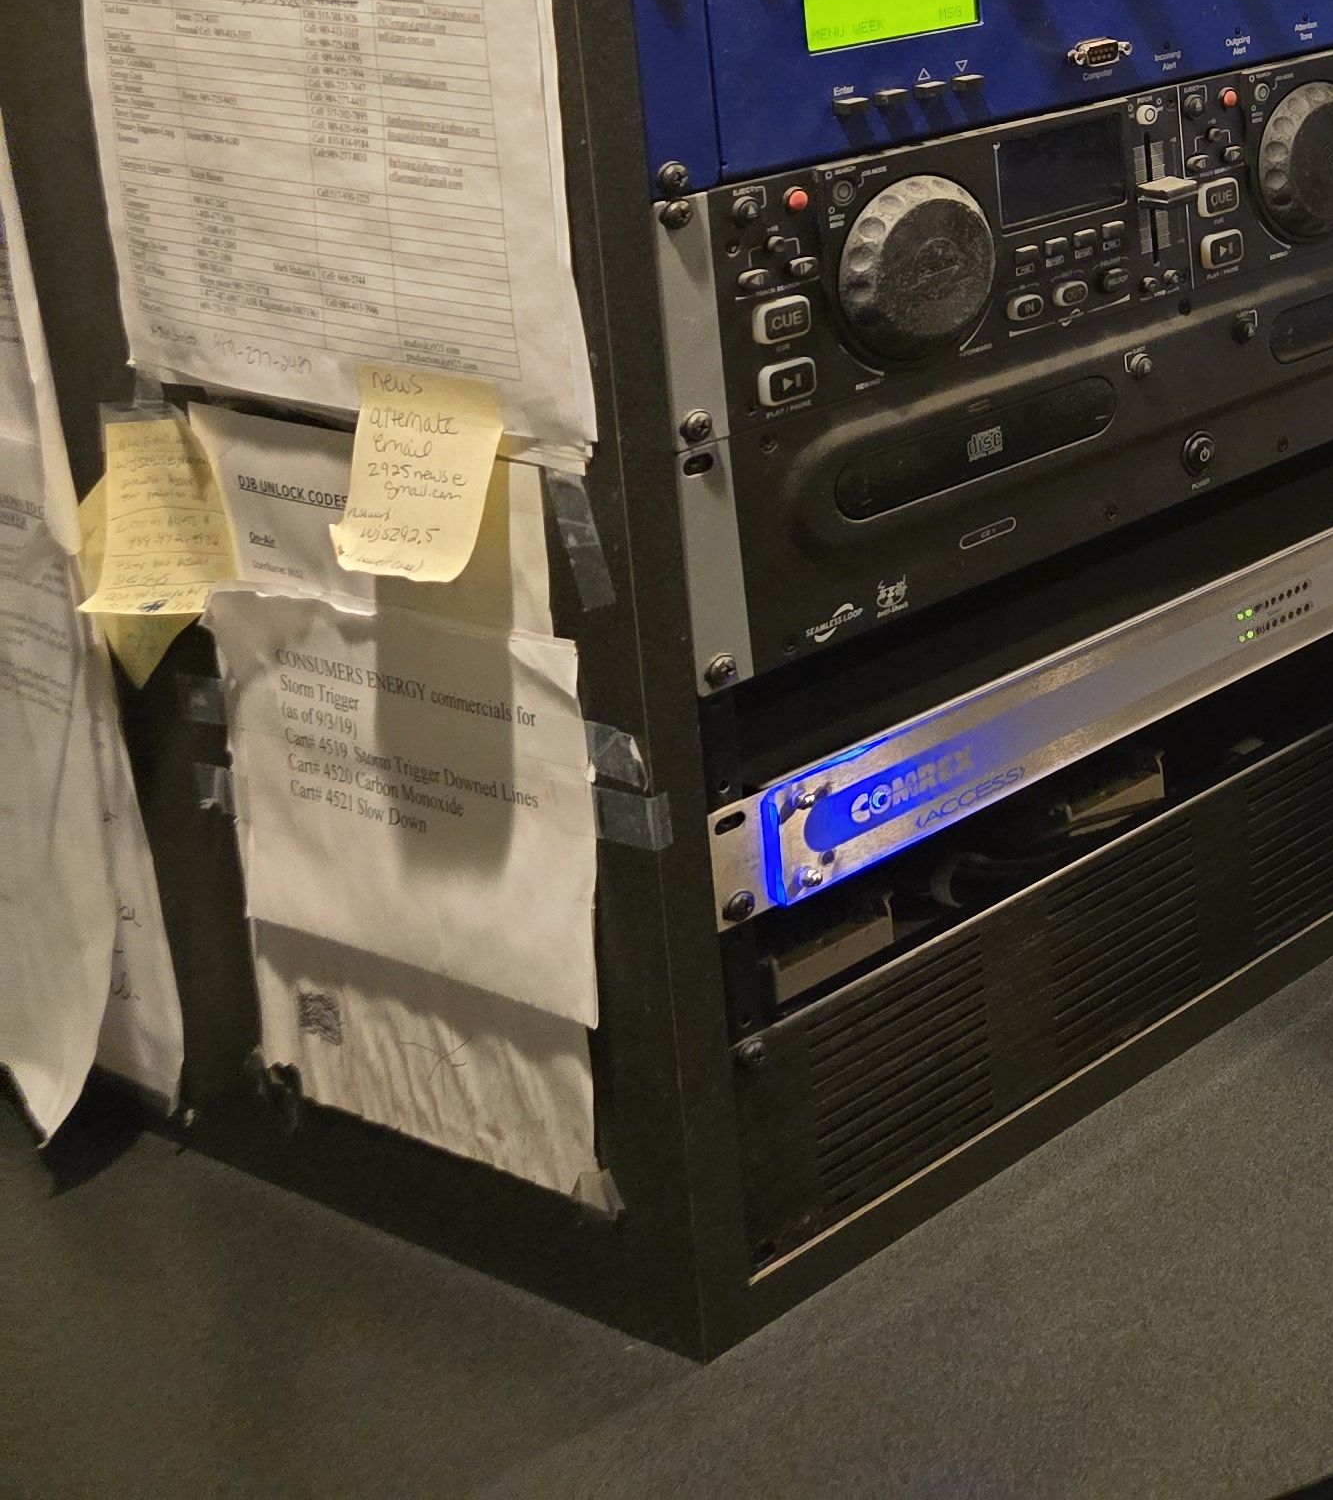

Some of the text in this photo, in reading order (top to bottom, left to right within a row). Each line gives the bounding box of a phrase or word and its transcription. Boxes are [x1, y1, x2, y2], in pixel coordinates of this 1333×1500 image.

[811, 5, 962, 43] MENU WEEK MSG
[1295, 20, 1317, 32] Attention
[1226, 34, 1251, 48] Outgoing
[1299, 31, 1313, 41] Tone
[1154, 48, 1181, 62] Incoming
[1232, 45, 1246, 55] Alert
[1082, 68, 1113, 82] Computer
[1162, 60, 1177, 71] Alert
[833, 85, 854, 96] Enter
[1209, 189, 1234, 206] CUE
[770, 310, 803, 331] CUE
[372, 371, 423, 394] news
[238, 474, 348, 508] DJB UNLOCK CODES
[805, 608, 863, 638] SEAMLESS LOOP
[276, 649, 536, 727] CONSUMERS ENERGY commercials for
[280, 675, 360, 712] Storm Trigger
[281, 701, 357, 740] (as of 9/3/19)
[285, 727, 538, 809] Cart# 4519 Storm Trigger Downed Lines
[288, 754, 464, 818] Cart# 4520 Carbon Monoxide
[851, 745, 974, 824] COMREX
[290, 780, 426, 833] Cart# 4521 Slow Down
